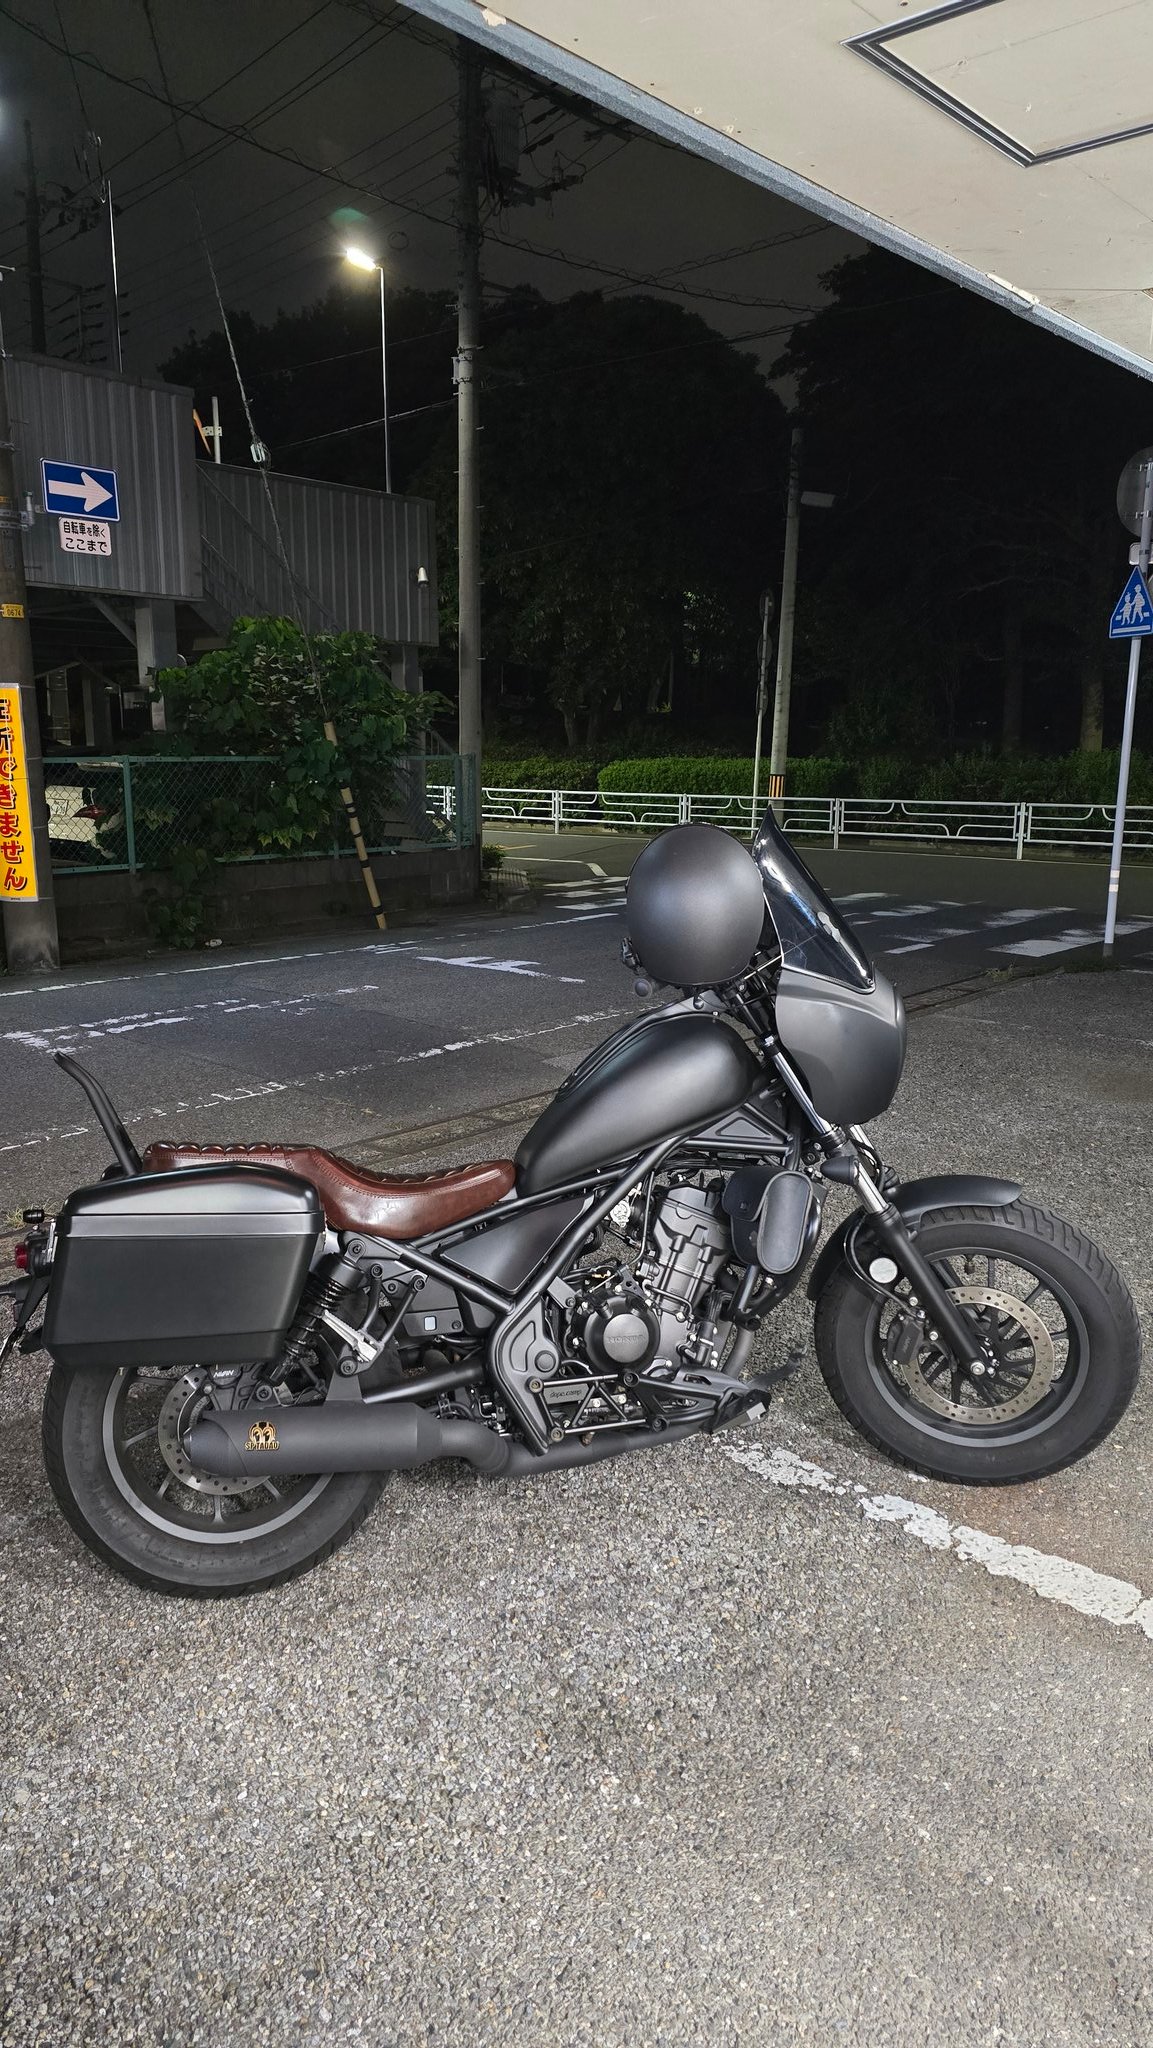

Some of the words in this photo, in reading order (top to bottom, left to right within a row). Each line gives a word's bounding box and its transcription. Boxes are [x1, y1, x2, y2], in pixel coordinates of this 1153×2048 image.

[63, 520, 106, 538] 自転車を除く
[65, 537, 108, 553] ここまで
